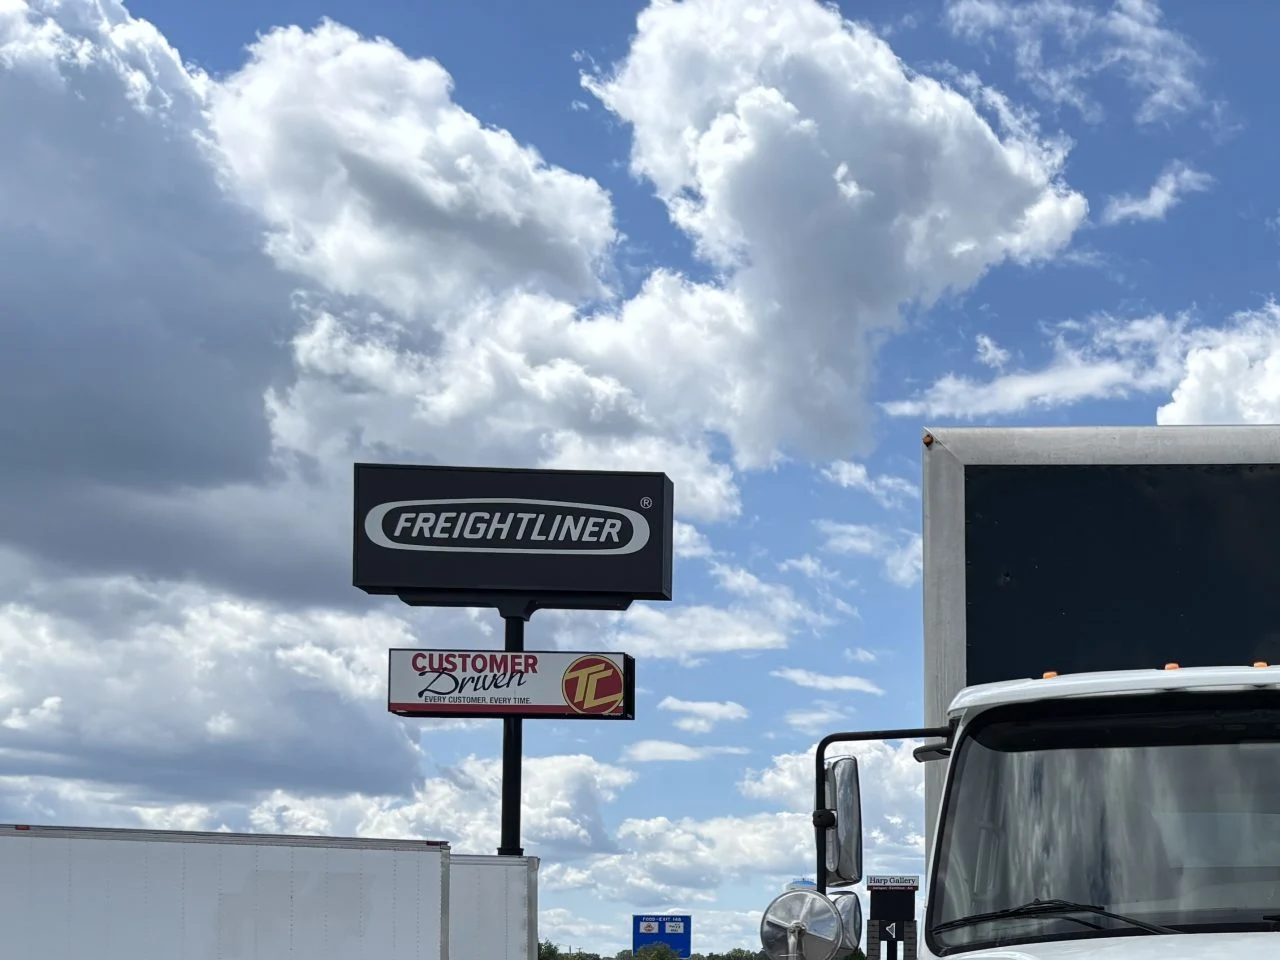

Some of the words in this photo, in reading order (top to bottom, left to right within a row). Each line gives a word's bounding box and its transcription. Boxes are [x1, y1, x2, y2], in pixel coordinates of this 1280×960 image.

[393, 511, 622, 543] FREIGHTLINER
[411, 652, 538, 674] CUSTOMER
[417, 668, 527, 698] Driven
[424, 695, 447, 703] EVERY
[870, 876, 888, 885] Harp
[889, 876, 916, 885] Gallery
